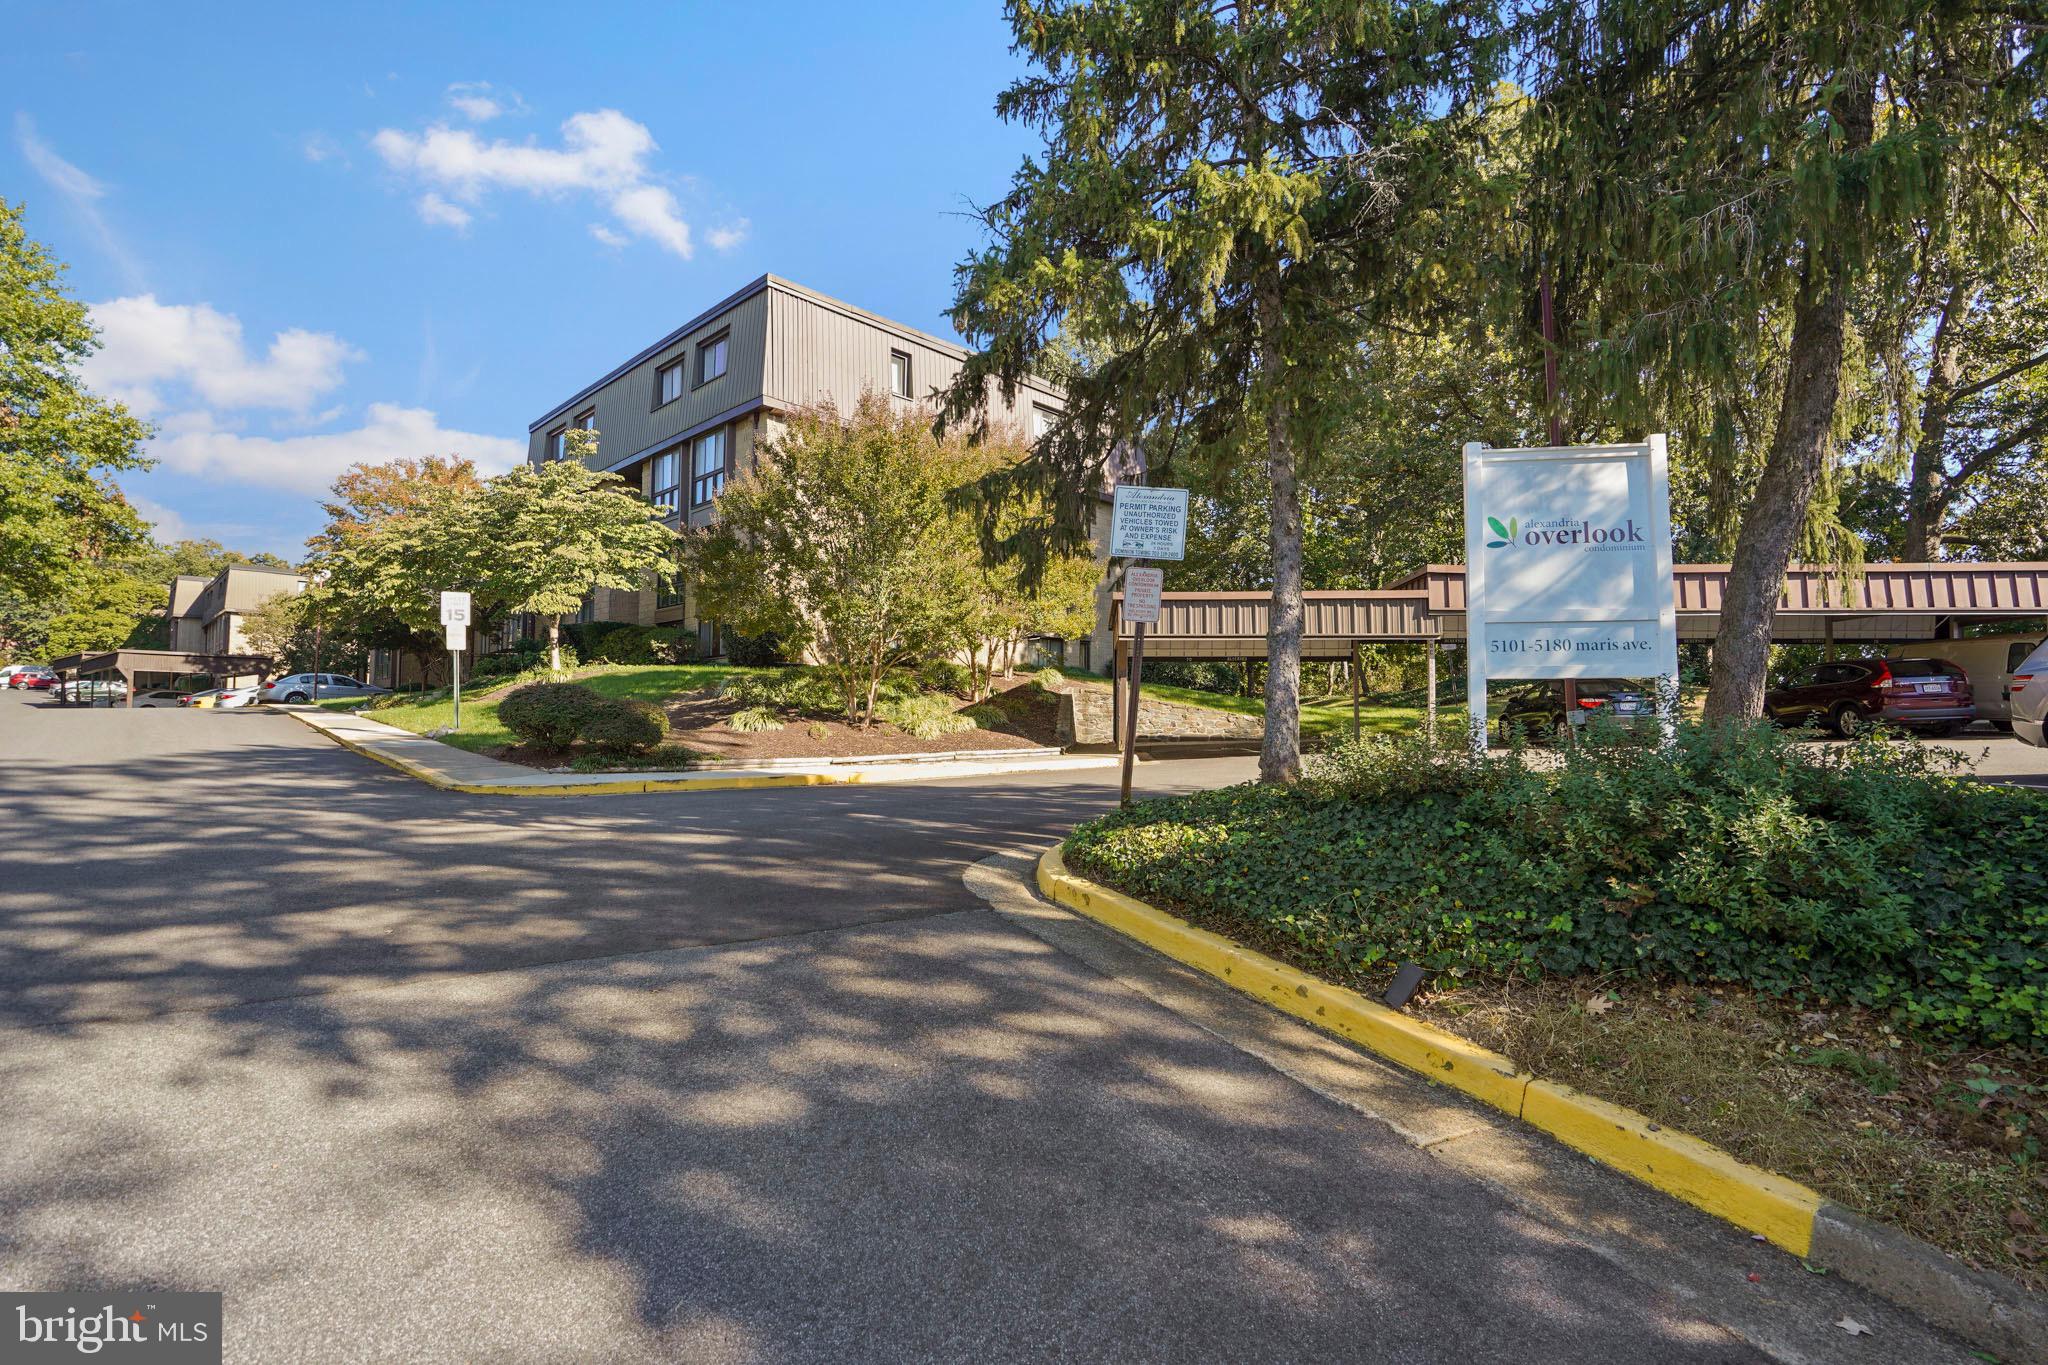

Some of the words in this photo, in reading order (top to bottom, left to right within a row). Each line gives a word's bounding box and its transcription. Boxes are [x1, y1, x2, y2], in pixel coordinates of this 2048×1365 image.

[1119, 502, 1148, 511] PERMIT
[1149, 504, 1182, 513] PARKING
[1123, 510, 1177, 520] UNAUTHORIZED
[1120, 517, 1153, 526] VEHICLES
[1524, 518, 1580, 529] alexandria
[1129, 525, 1160, 533] OWNER'S
[1525, 519, 1645, 546] overlook
[1124, 532, 1139, 540] AND
[1141, 533, 1172, 542] EXPENSE
[1584, 543, 1646, 552] condominium
[447, 609, 465, 621] 15
[1490, 638, 1572, 653] 5101-5180
[1576, 638, 1619, 651] maris
[1622, 640, 1652, 651] ave.
